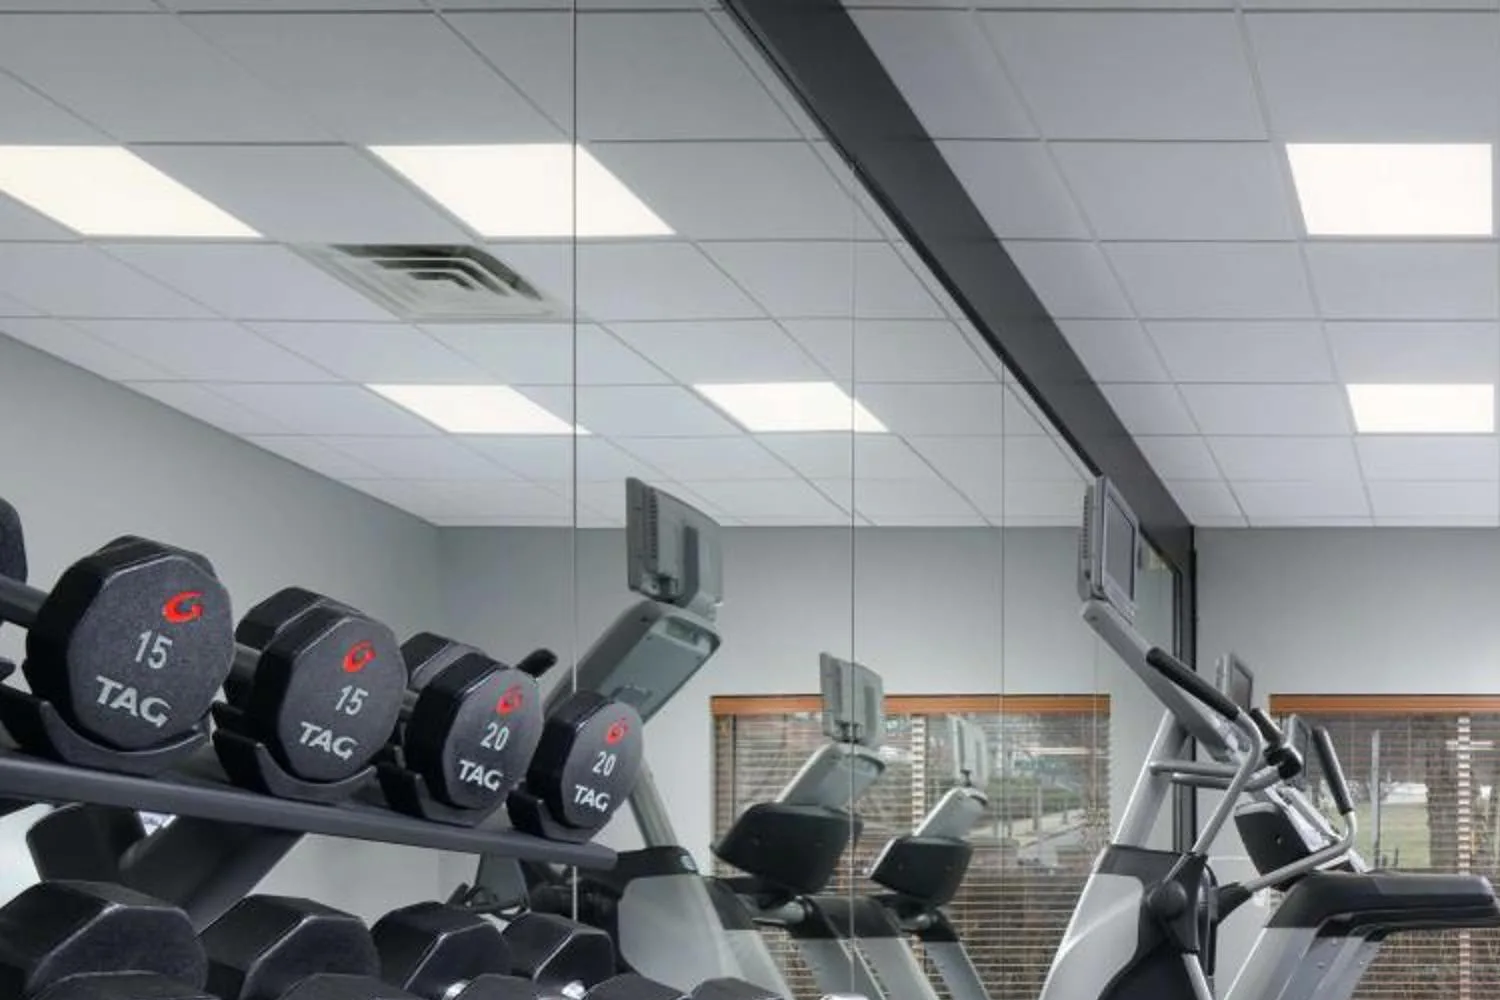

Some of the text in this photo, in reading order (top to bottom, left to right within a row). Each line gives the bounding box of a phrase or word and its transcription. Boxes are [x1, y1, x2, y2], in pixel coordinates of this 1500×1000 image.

[136, 631, 172, 668] 15
[97, 676, 168, 726] TAG
[336, 686, 368, 715] 15
[301, 722, 355, 759] TAG
[481, 722, 509, 750] 20
[460, 760, 502, 790] TAG
[593, 751, 616, 776] 20
[575, 785, 609, 811] TAG
